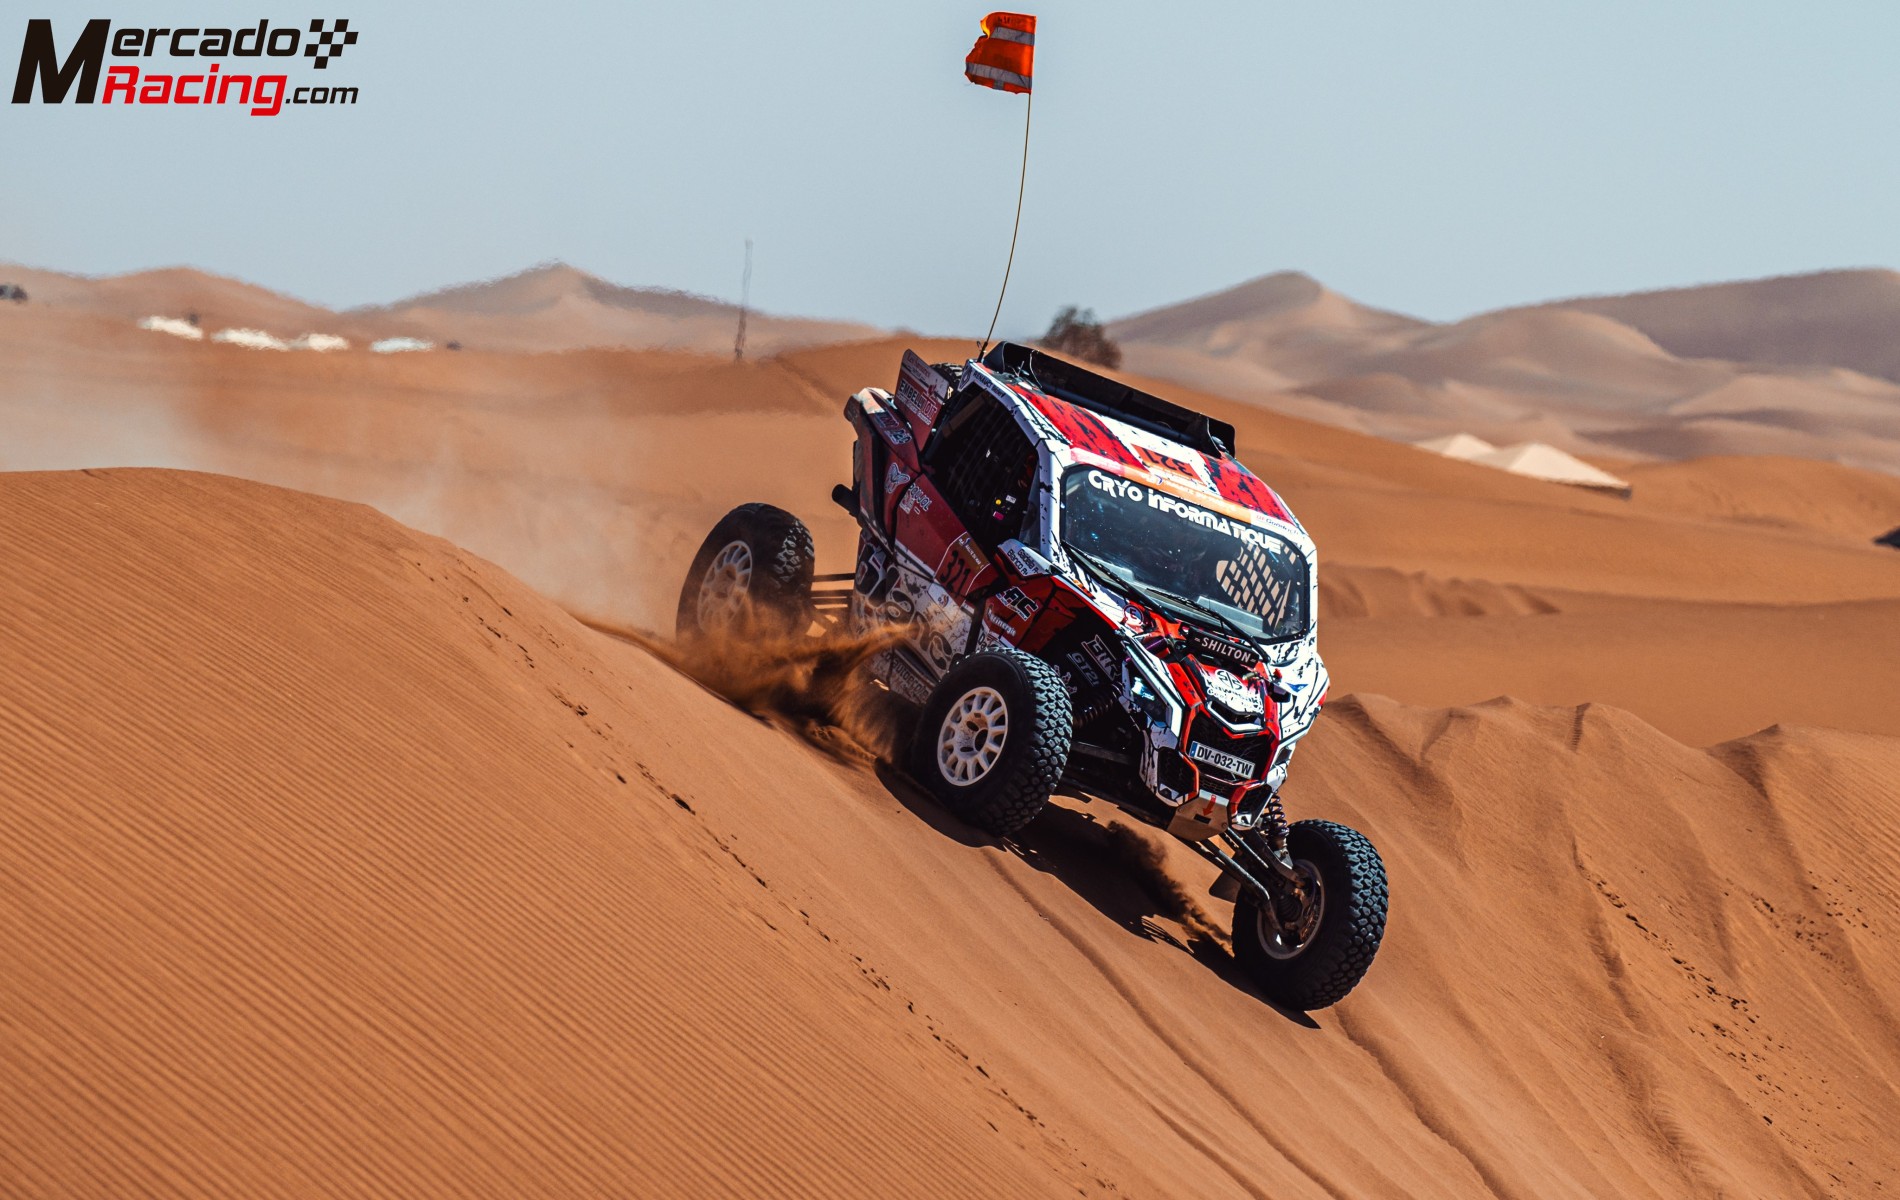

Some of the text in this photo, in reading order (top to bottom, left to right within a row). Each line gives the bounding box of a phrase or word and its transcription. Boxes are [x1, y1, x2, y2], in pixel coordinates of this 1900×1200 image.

[1088, 470, 1143, 501] CRYO
[1007, 548, 1024, 570] Blanco
[1202, 637, 1251, 663] SHILTON
[1197, 746, 1252, 776] DV-032-TW
